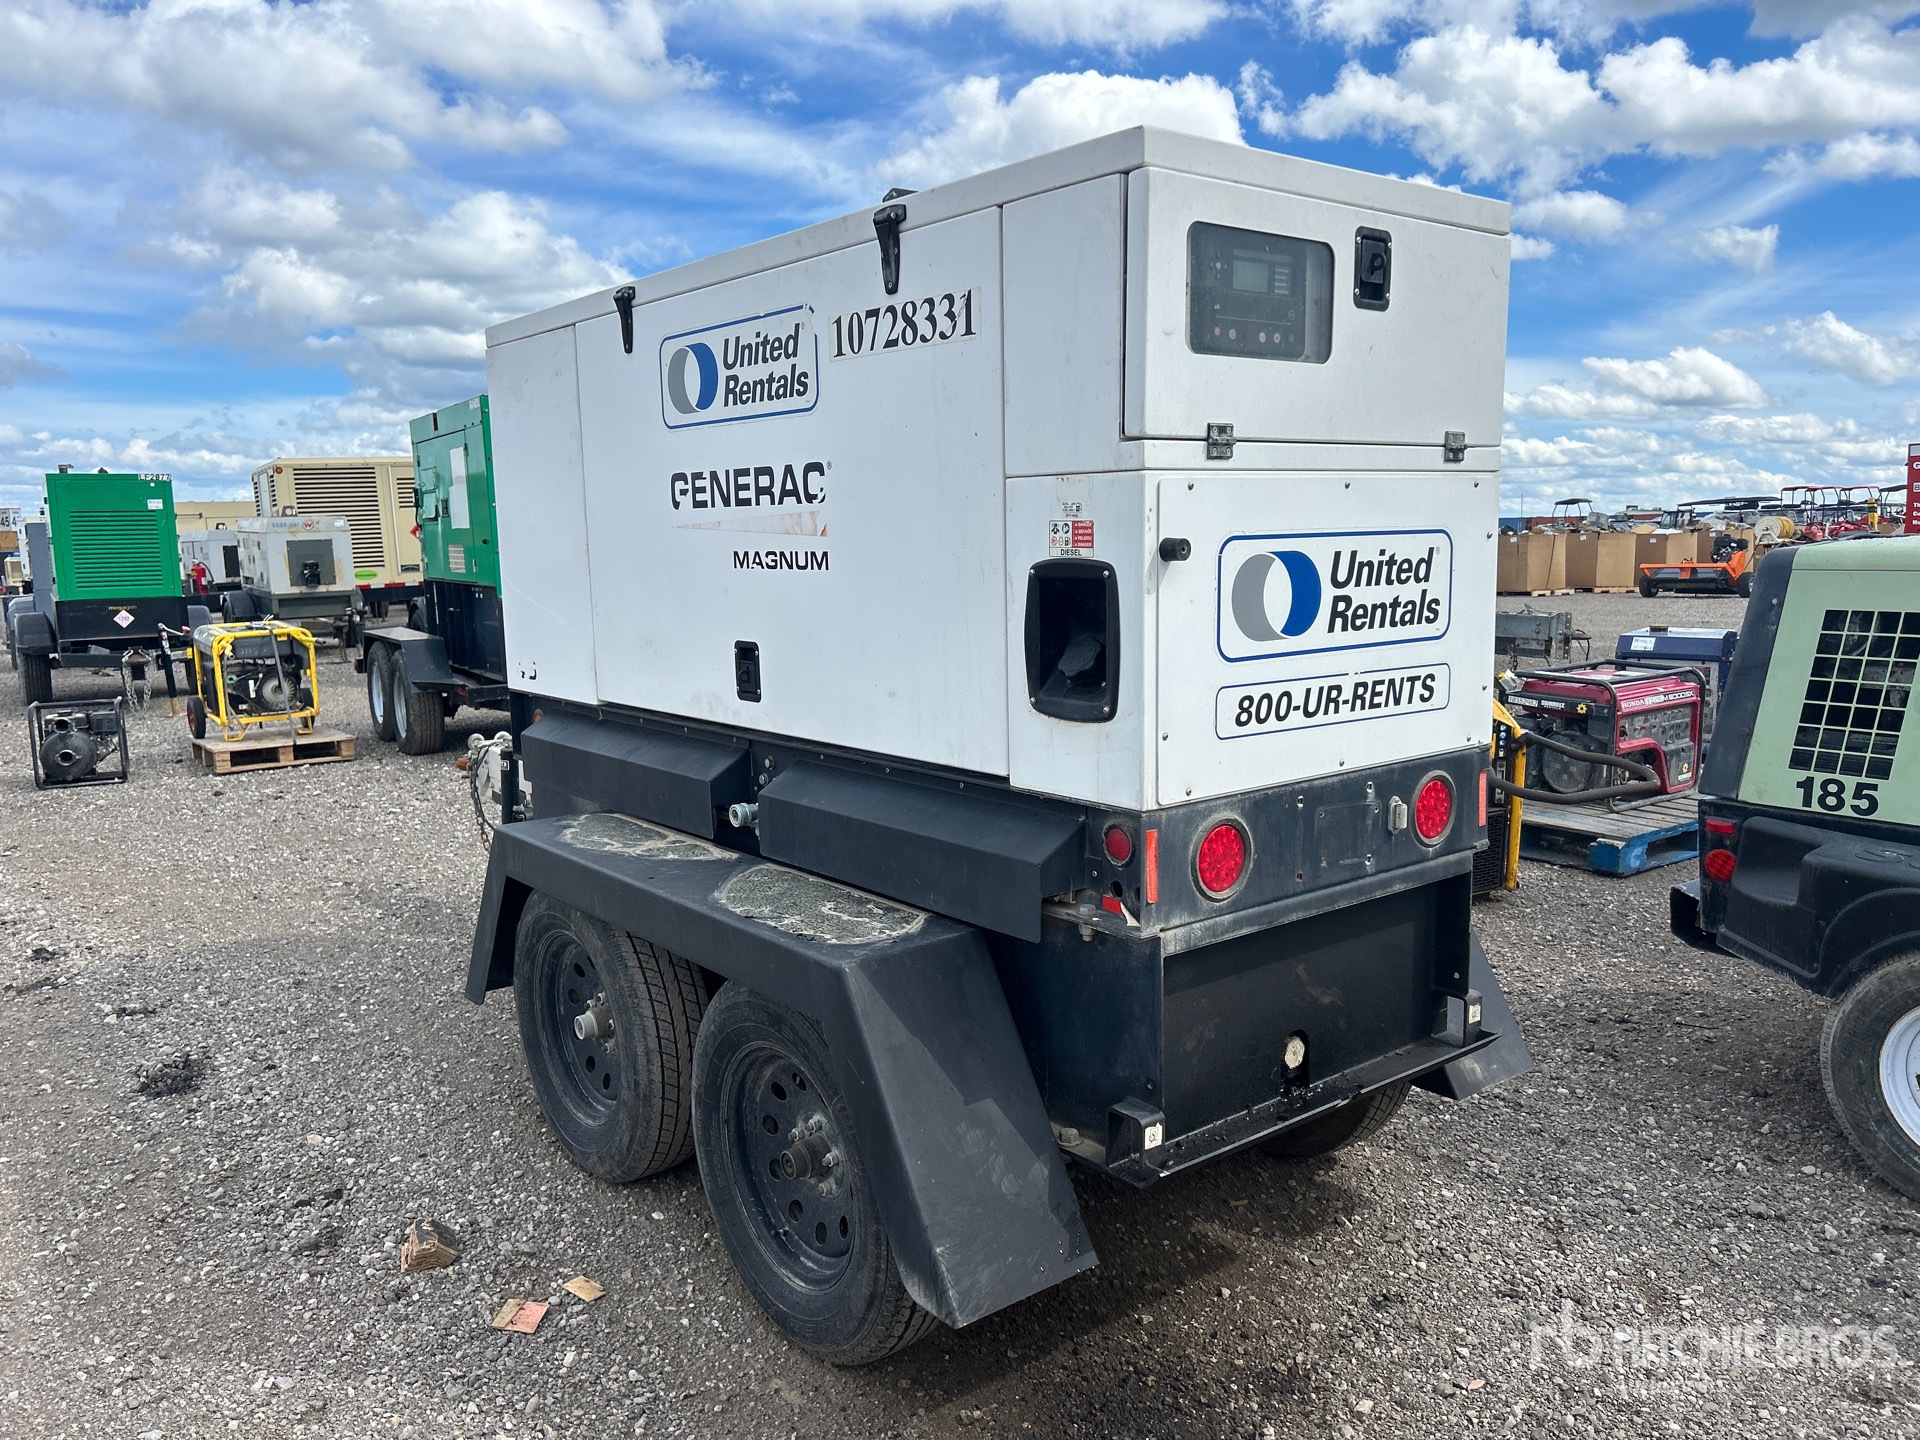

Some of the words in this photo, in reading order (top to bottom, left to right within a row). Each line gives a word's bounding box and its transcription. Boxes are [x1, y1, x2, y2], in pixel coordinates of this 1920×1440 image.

[832, 288, 977, 358] 10728331
[723, 322, 802, 371] United
[723, 363, 809, 407] Rentals
[670, 461, 827, 511] GENERAC
[733, 550, 829, 570] MAGNUM
[1060, 548, 1082, 556] DIESEL
[1331, 546, 1435, 589] United
[1327, 589, 1440, 633] Rentals
[1235, 673, 1436, 728] 800-UR-RENTS
[1621, 699, 1645, 709] HONDA
[1795, 776, 1879, 817] 185
